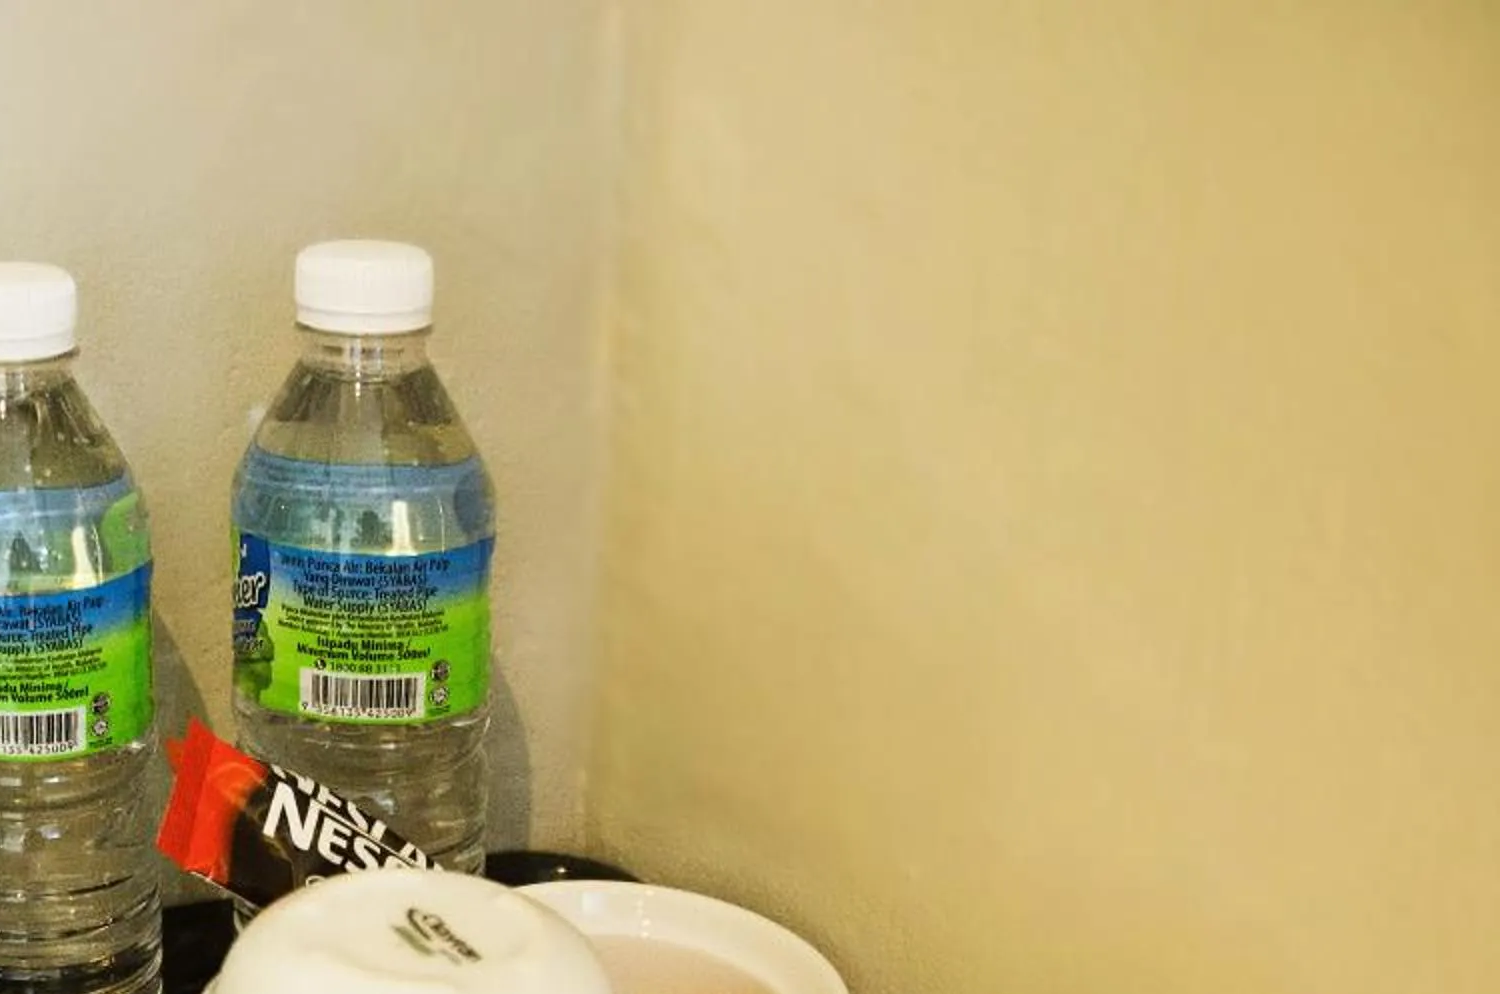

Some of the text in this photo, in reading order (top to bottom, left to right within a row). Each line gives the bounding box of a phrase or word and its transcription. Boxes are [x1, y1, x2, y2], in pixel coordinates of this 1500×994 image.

[365, 559, 411, 574] Bekalan
[303, 595, 333, 610] Water
[335, 599, 376, 616] Supply
[11, 691, 53, 704] Volume
